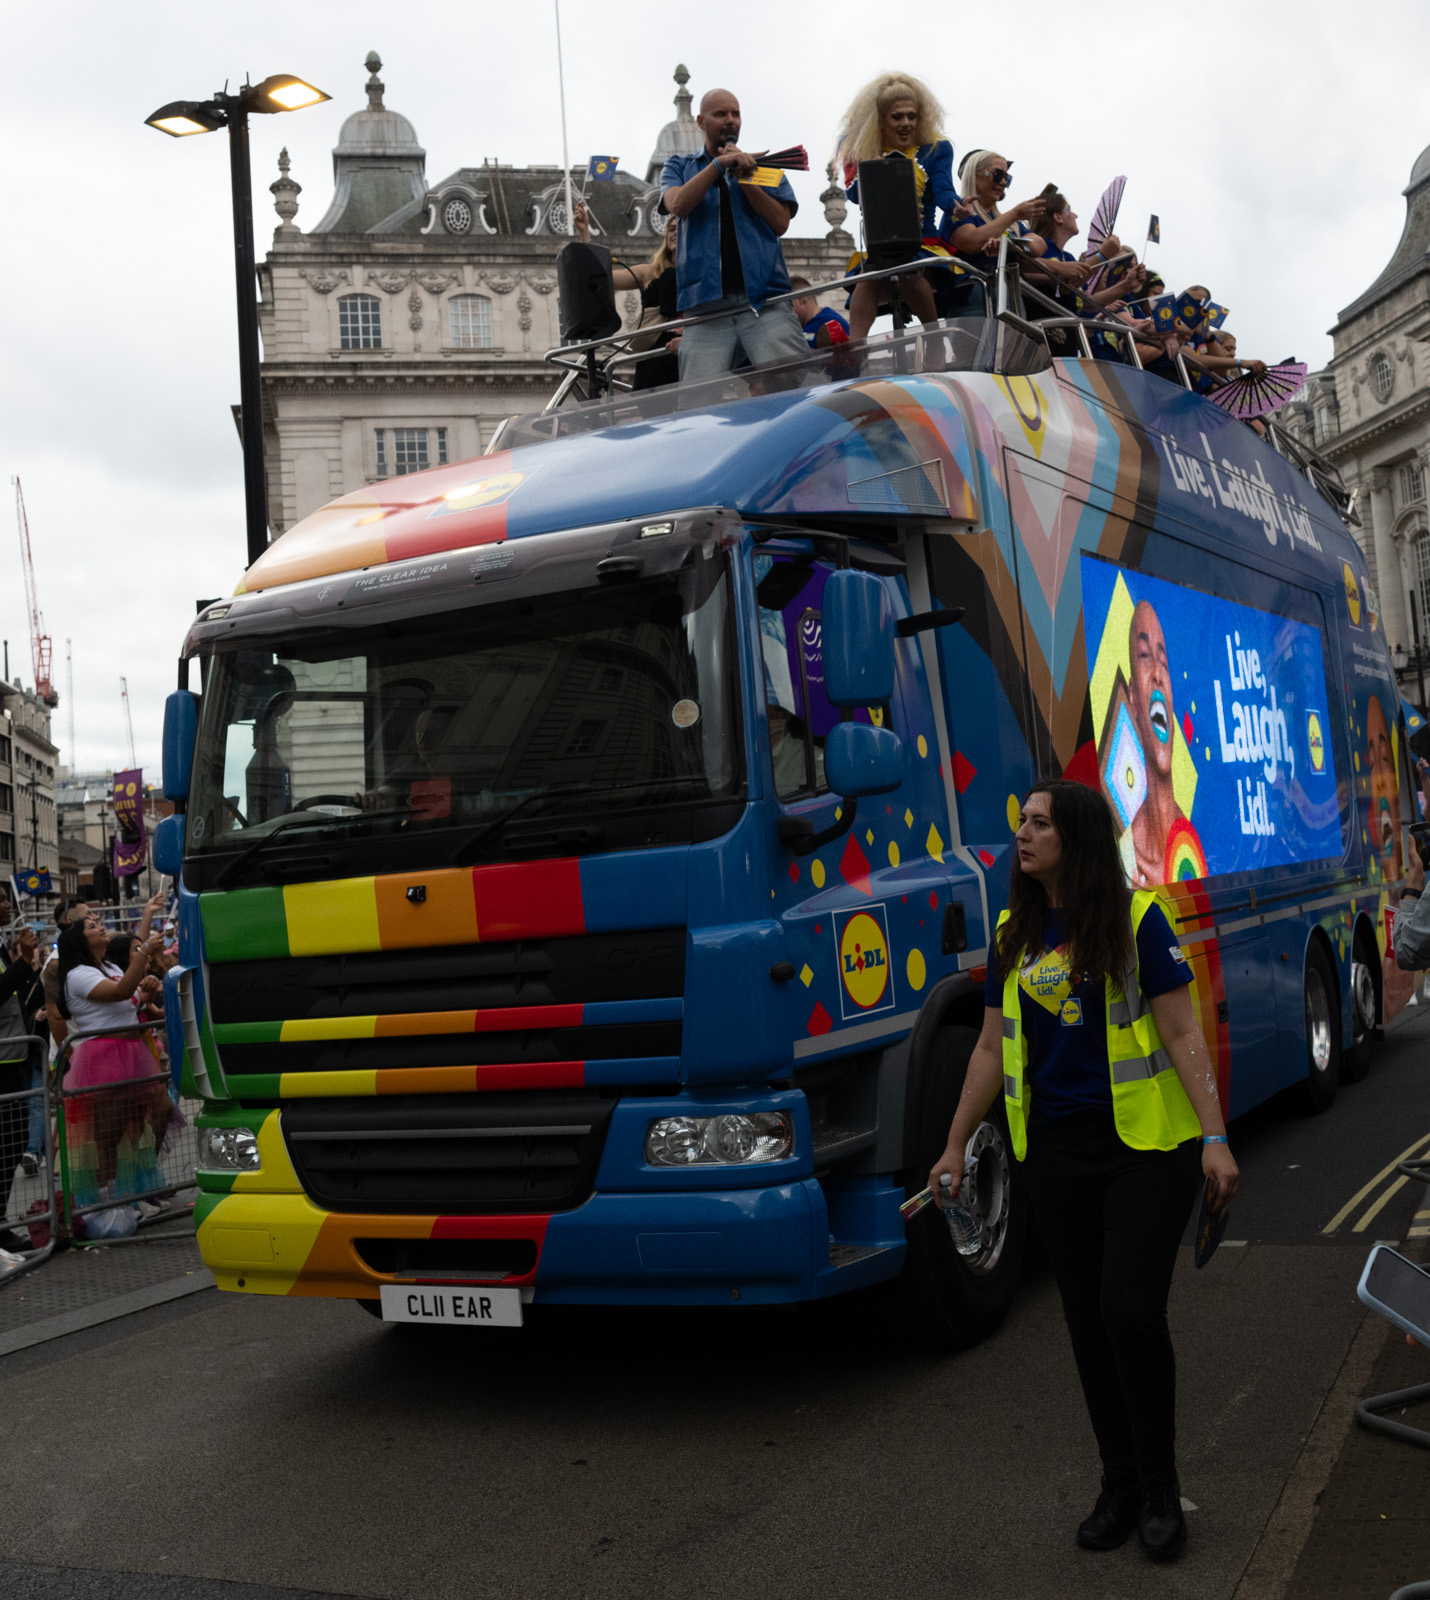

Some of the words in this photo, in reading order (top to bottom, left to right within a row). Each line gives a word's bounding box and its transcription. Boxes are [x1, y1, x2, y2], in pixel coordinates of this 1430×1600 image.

[1161, 434, 1216, 509] Live,
[1199, 431, 1295, 552] Laugh,
[1283, 493, 1323, 553] Lidl.
[354, 577, 376, 588] THE
[379, 569, 416, 583] CLEAR
[420, 563, 448, 575] IDEA
[1226, 631, 1267, 698] Live,
[1213, 679, 1295, 785] Laugh,
[1237, 776, 1275, 836] Lidl.
[1039, 965, 1061, 975] Live,
[215, 973, 304, 996] DAF
[1036, 986, 1057, 996] Lidl.
[406, 1294, 445, 1317] CL11
[452, 1296, 493, 1319] EAR
